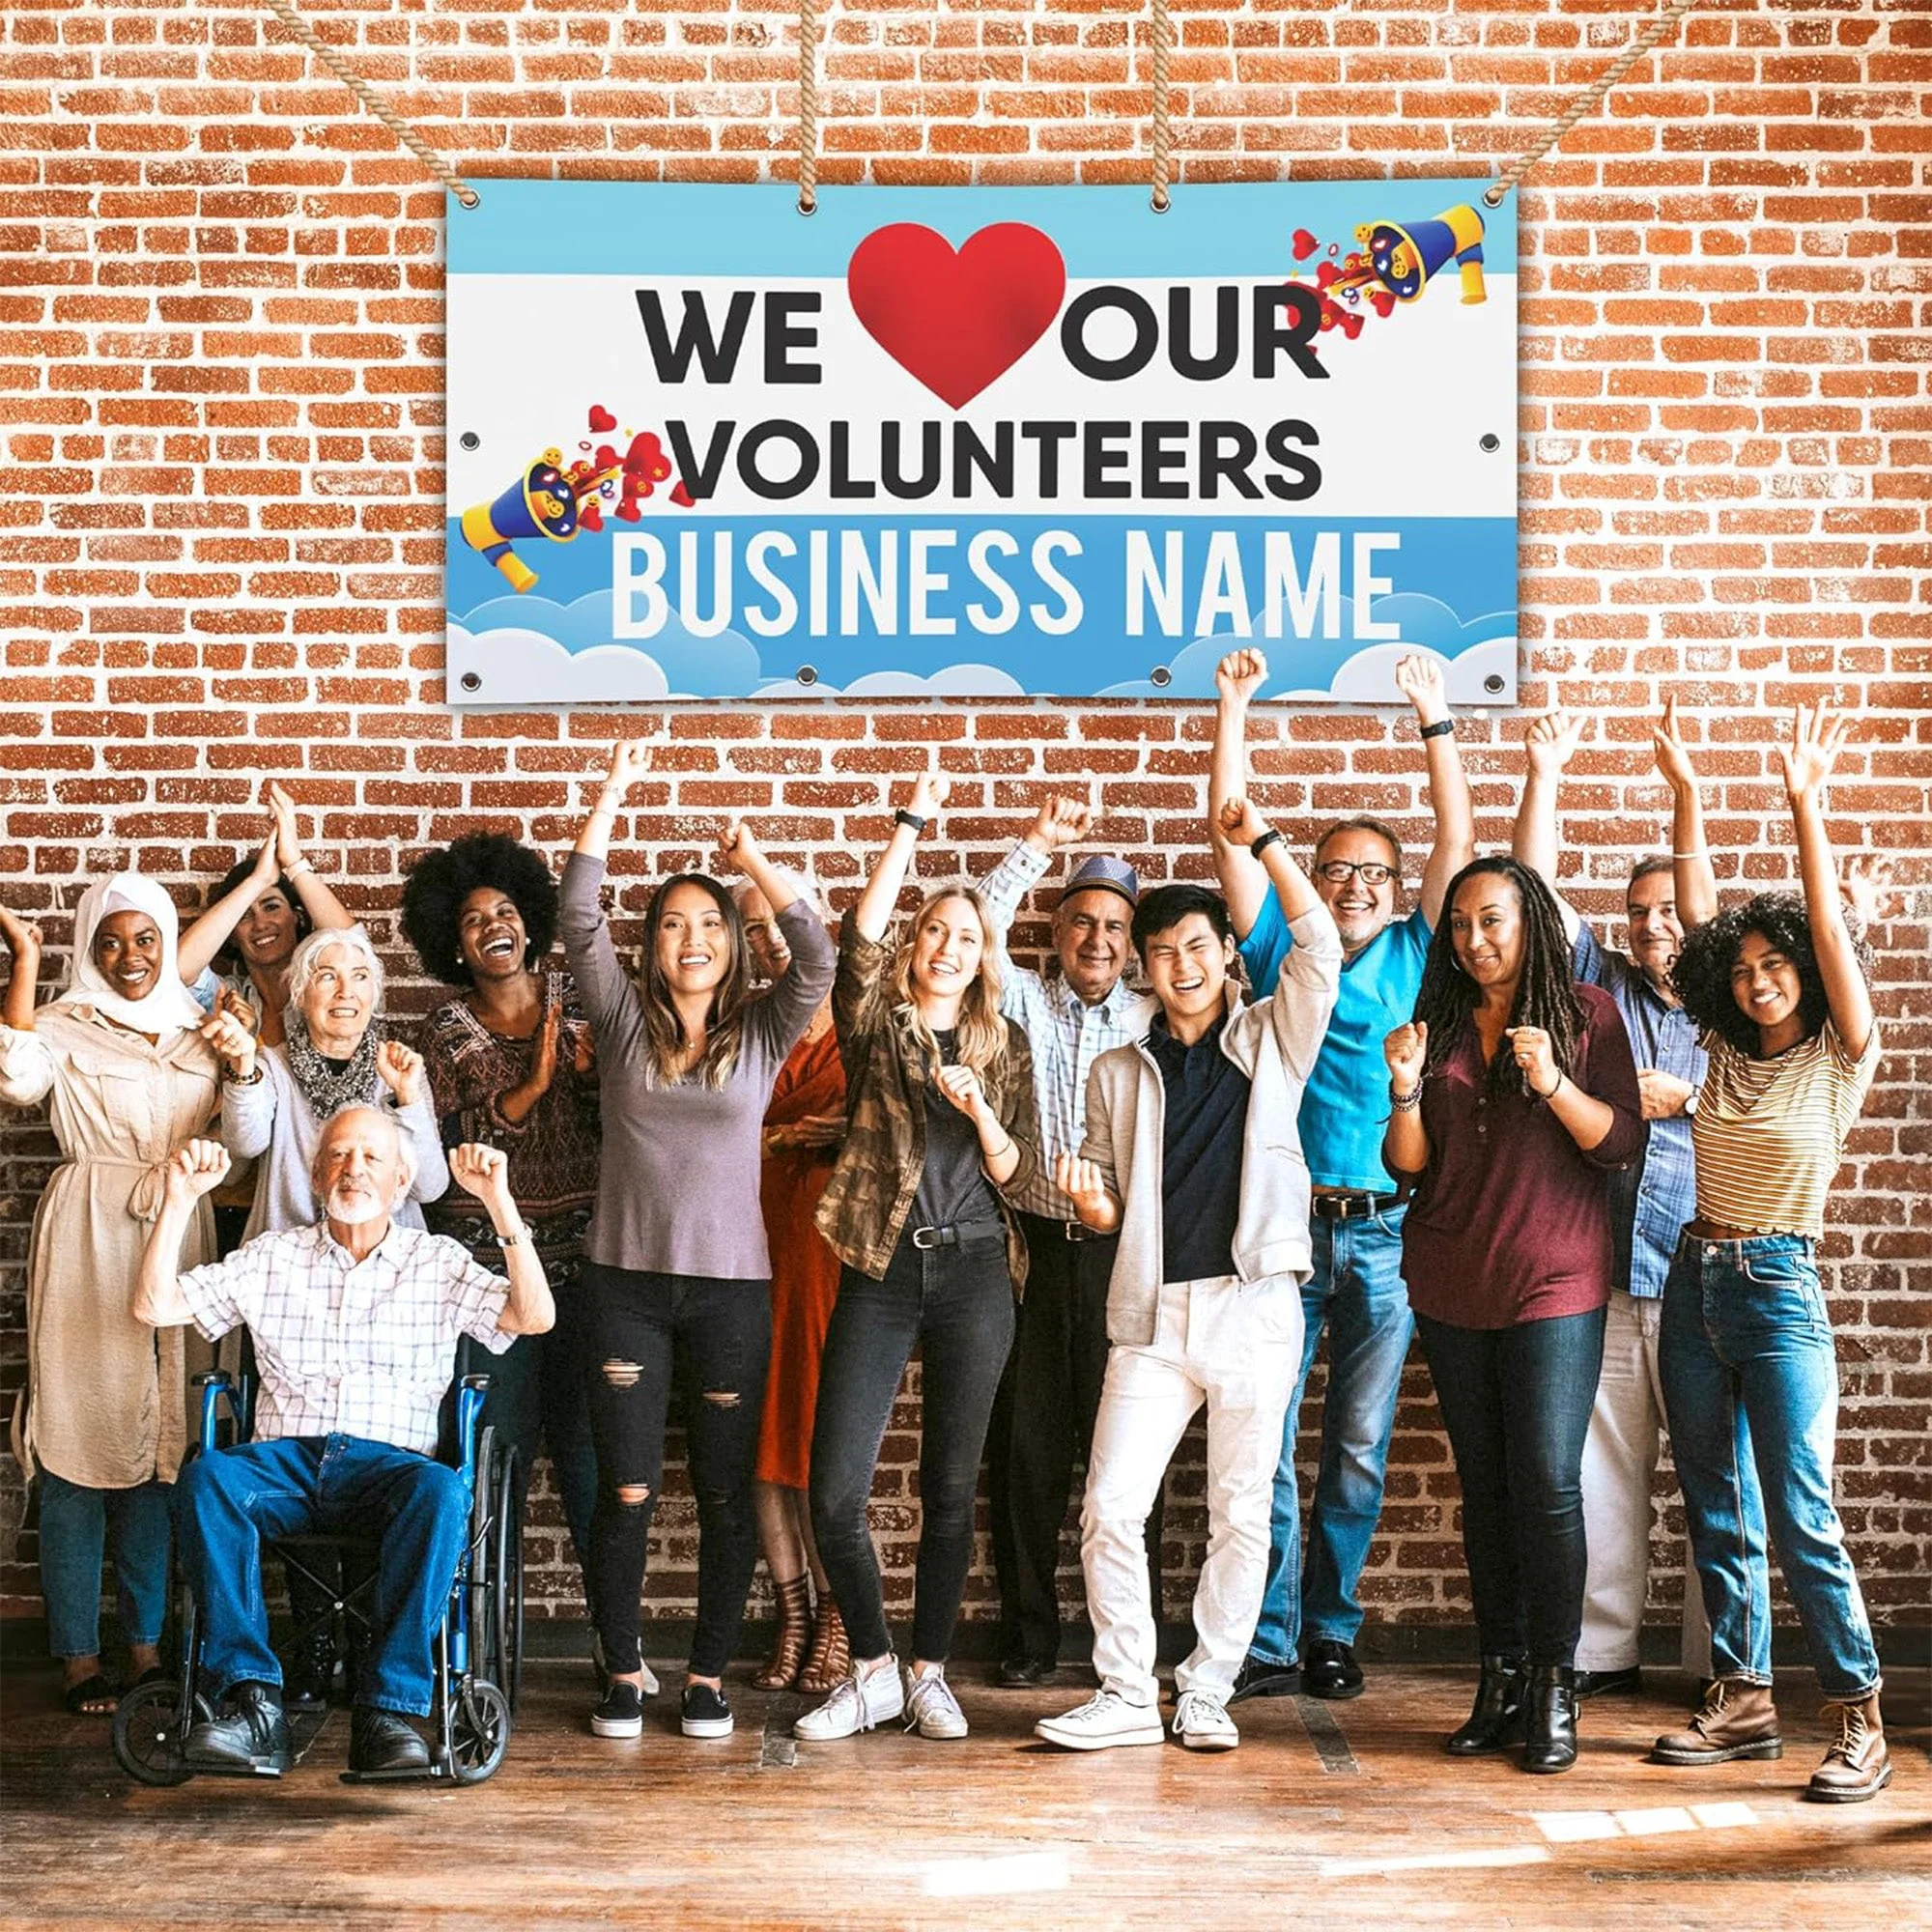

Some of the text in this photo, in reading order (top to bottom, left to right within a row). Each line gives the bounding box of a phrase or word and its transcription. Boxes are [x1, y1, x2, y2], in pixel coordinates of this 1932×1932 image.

[635, 285, 1331, 384] WE OUR
[665, 419, 1322, 500] VOLUNTEERS
[611, 529, 1401, 639] BUSINESS NAME
